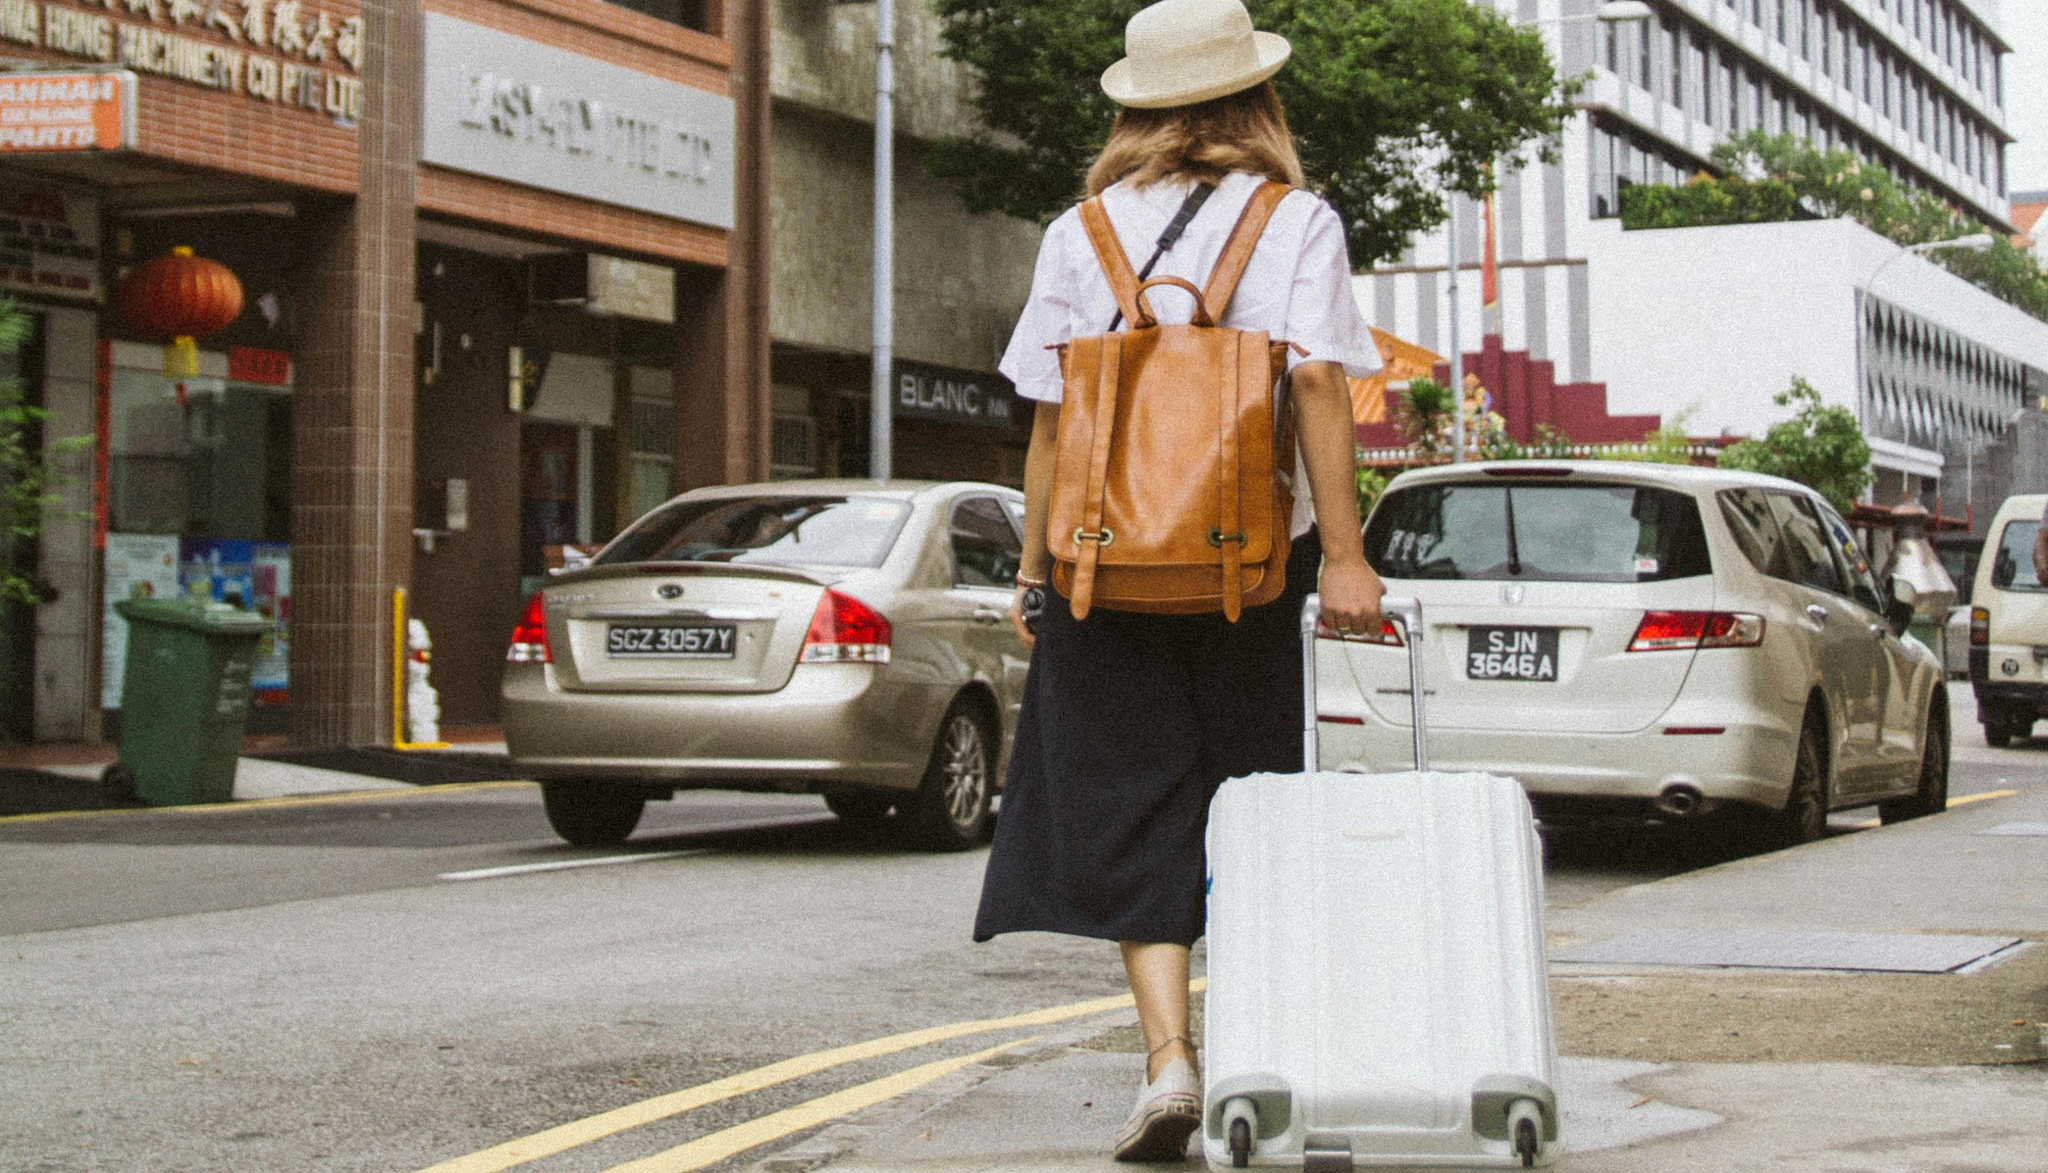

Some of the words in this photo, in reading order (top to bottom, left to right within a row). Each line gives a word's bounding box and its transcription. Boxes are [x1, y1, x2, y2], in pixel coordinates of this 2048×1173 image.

[46, 3, 114, 60] HONG
[119, 22, 243, 91] MACHINERY
[247, 53, 277, 99] CO
[900, 373, 979, 415] BLANC
[608, 628, 654, 651] SGZ
[655, 628, 732, 651] 3057Y
[1487, 630, 1538, 653] SJN
[1469, 652, 1554, 677] 3646A
